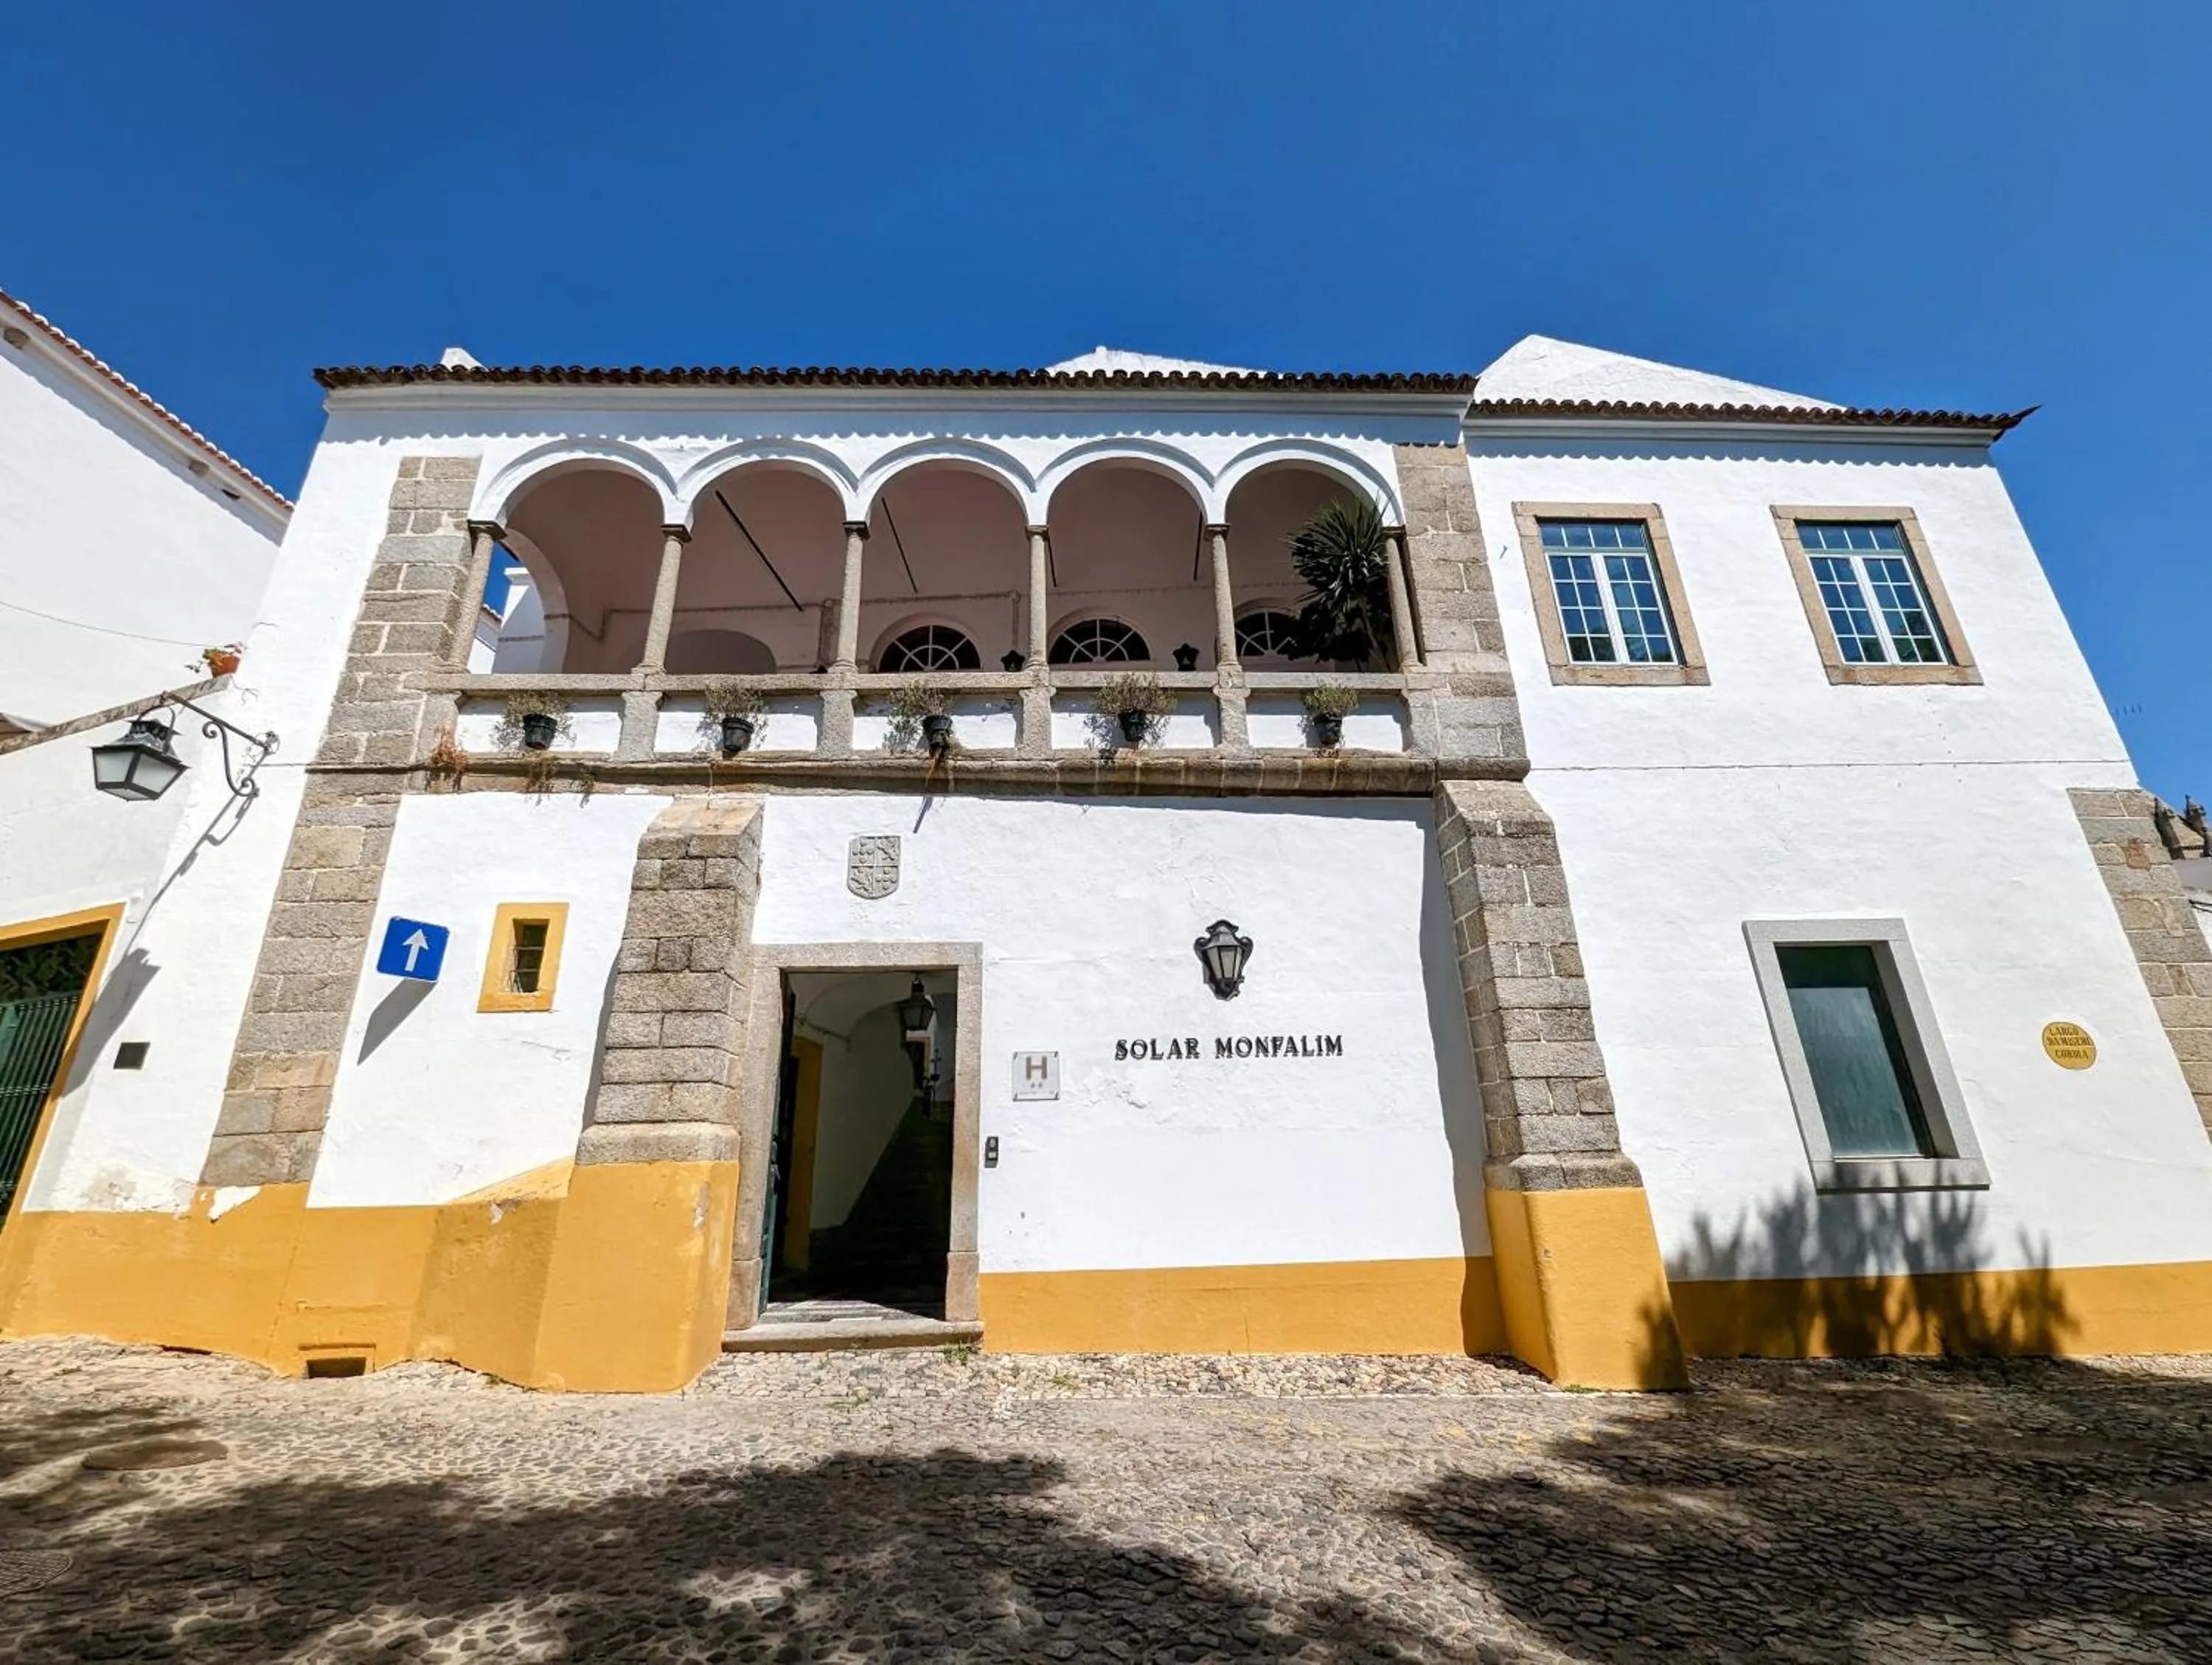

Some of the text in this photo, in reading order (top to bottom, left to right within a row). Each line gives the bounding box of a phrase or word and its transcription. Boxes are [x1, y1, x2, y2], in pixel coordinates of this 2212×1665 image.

[1114, 1035, 1344, 1060] SOLAR MONFALIM
[1026, 1055, 1048, 1080] H
